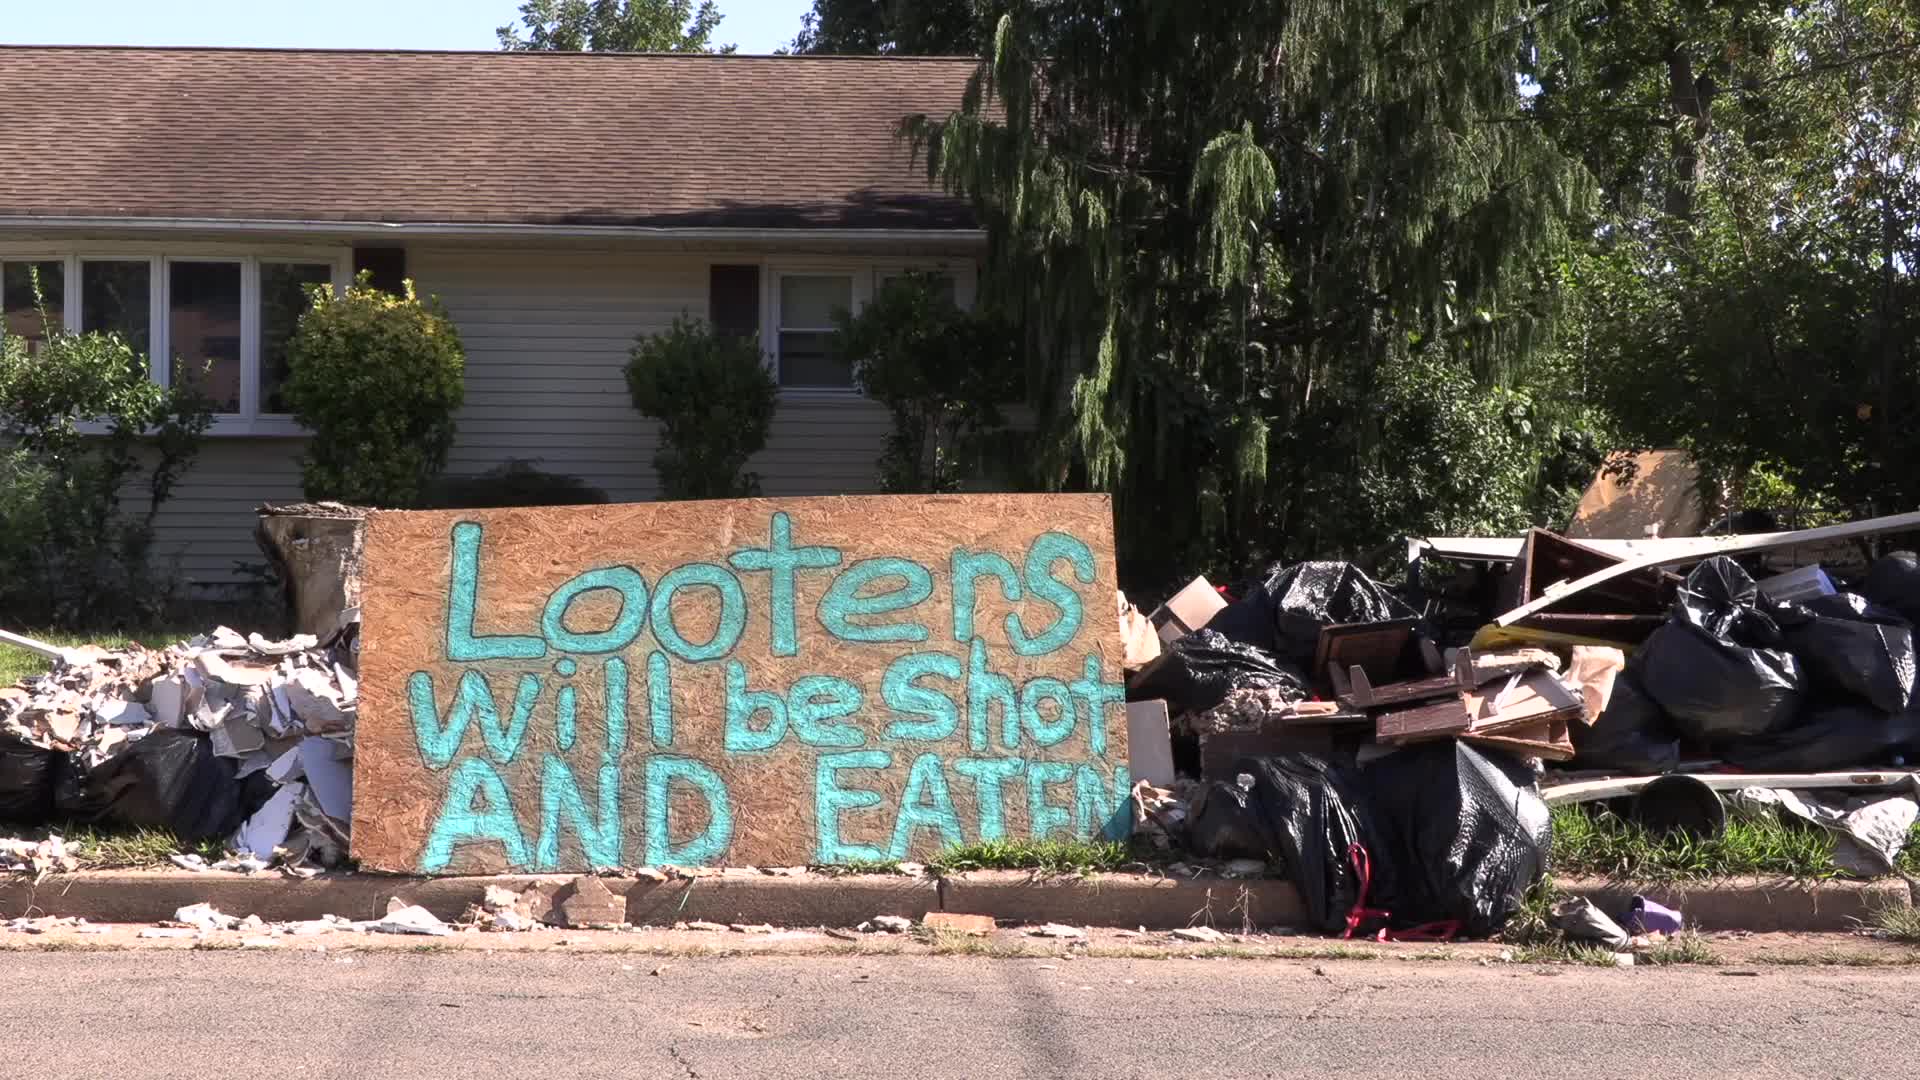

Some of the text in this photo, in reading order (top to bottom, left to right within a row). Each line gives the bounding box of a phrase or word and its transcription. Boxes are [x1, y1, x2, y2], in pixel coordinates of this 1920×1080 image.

[724, 660, 867, 754] be
[420, 748, 1131, 872] AND EATEN
